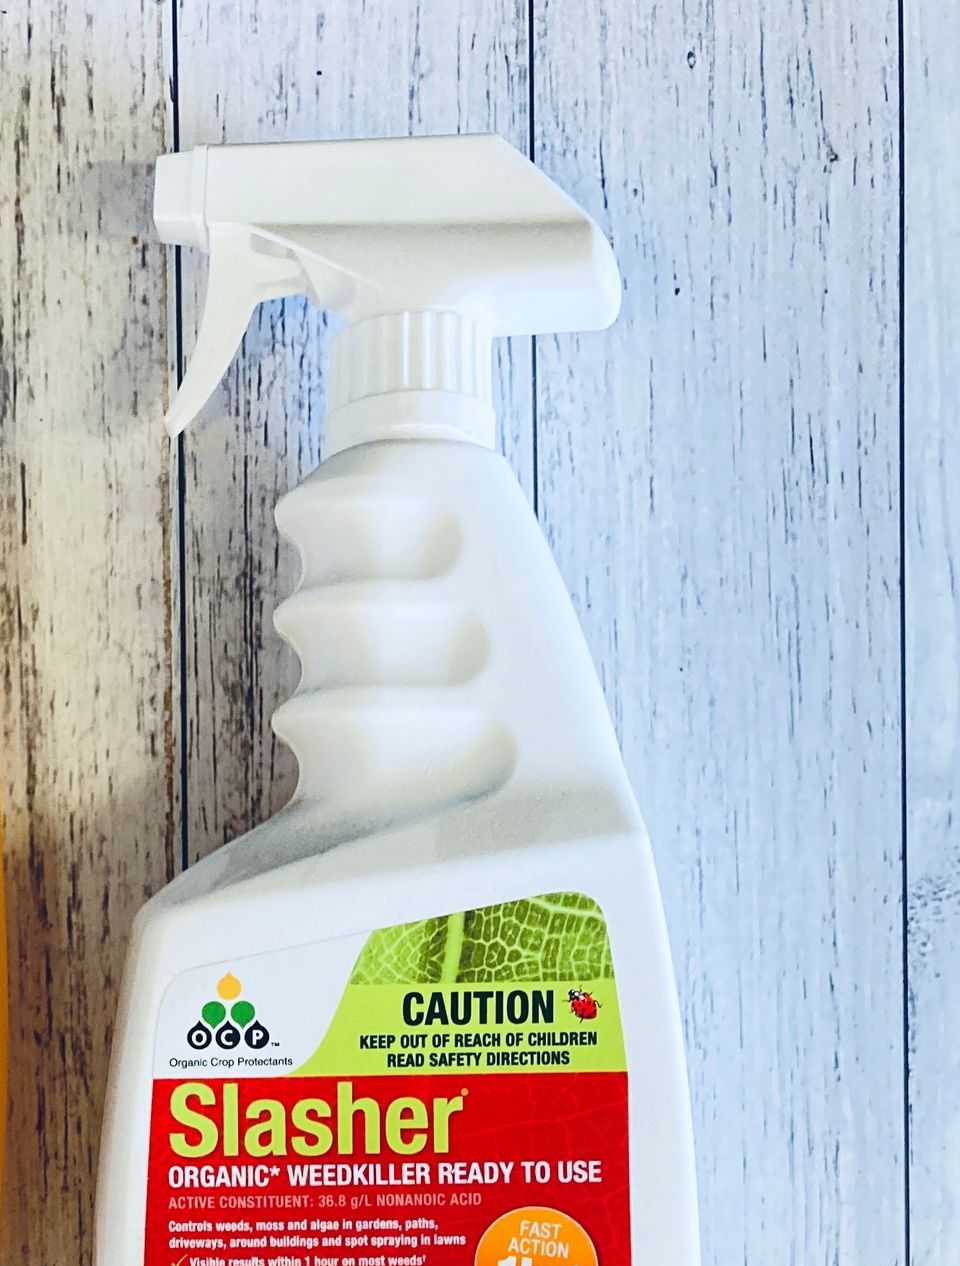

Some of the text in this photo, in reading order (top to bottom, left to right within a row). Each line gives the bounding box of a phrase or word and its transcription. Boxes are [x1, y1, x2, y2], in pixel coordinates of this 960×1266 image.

[402, 988, 553, 1027] CAUTION
[187, 1023, 270, 1050] OCP
[359, 1031, 597, 1049] KEEP OUT OF REACH OF CHILDREN
[169, 1055, 293, 1069] Organic Crop Protectants
[387, 1050, 570, 1067] READ SAFETY DIRECTIONS
[286, 1162, 430, 1186] WEEDKILLER
[438, 1161, 514, 1184] READY
[520, 1160, 550, 1183] TO
[557, 1159, 601, 1183] USE
[168, 1192, 481, 1209] ACTIVE CONSTITUENT: 36.8 g/L NONANOIC ACID
[168, 1219, 212, 1232] Controls
[215, 1219, 253, 1233] weeds,
[255, 1221, 284, 1231] moss
[287, 1218, 307, 1230] and
[310, 1218, 339, 1232] algae
[355, 1218, 402, 1232] gardens,
[404, 1217, 438, 1231] paths,
[520, 1220, 560, 1239] FAST
[168, 1236, 226, 1250] driveways,
[229, 1235, 267, 1248] around
[269, 1235, 319, 1249] buildings
[321, 1235, 341, 1246] and
[344, 1234, 368, 1248] spot
[370, 1233, 417, 1248] spraying
[433, 1233, 466, 1245] lawns
[508, 1237, 569, 1259] ACTION
[314, 1255, 339, 1266] hour
[341, 1257, 355, 1266] on
[358, 1255, 385, 1266] most
